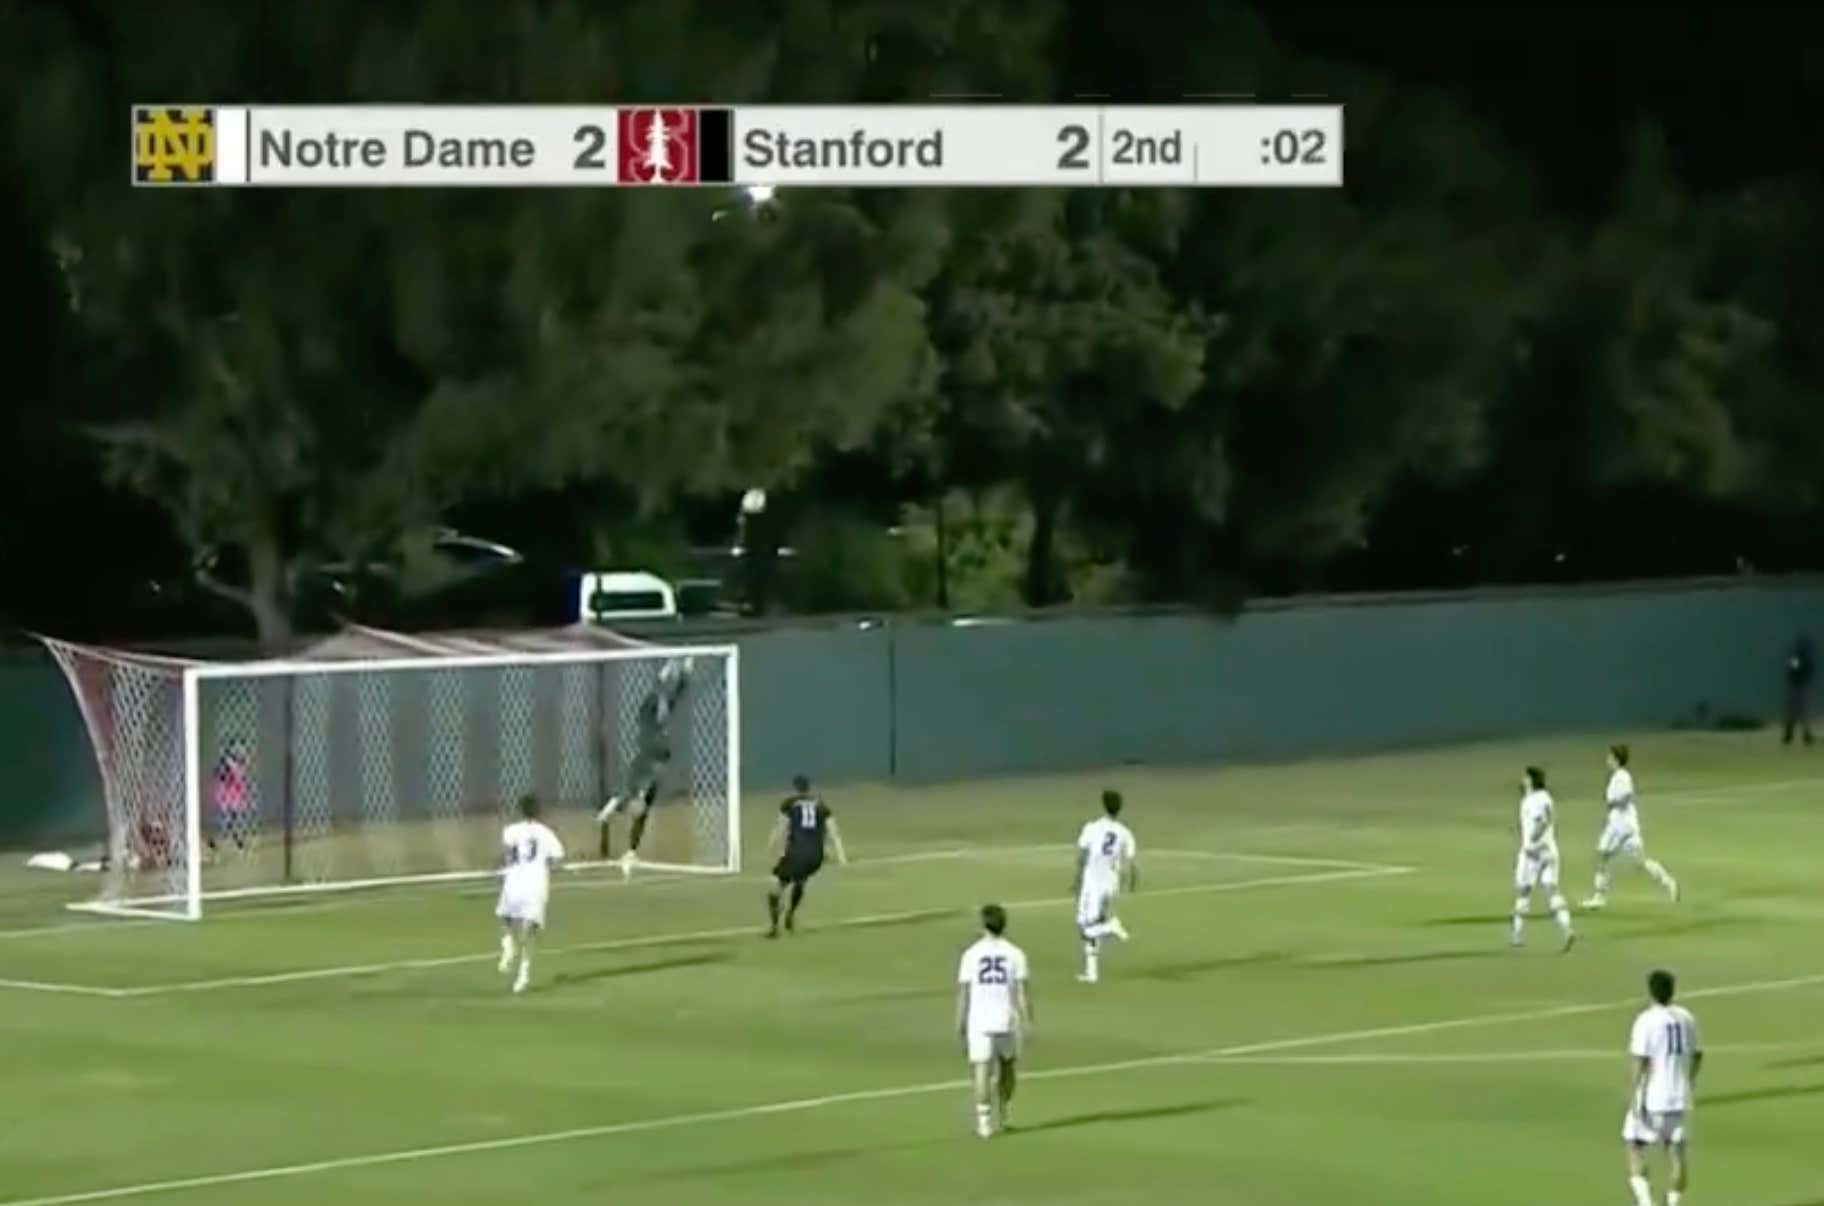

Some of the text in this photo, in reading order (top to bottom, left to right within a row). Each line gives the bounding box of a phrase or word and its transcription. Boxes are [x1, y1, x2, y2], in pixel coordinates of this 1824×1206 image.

[1102, 831, 1117, 855] 2
[979, 956, 1008, 984] 25
[1666, 1022, 1683, 1055] 11
